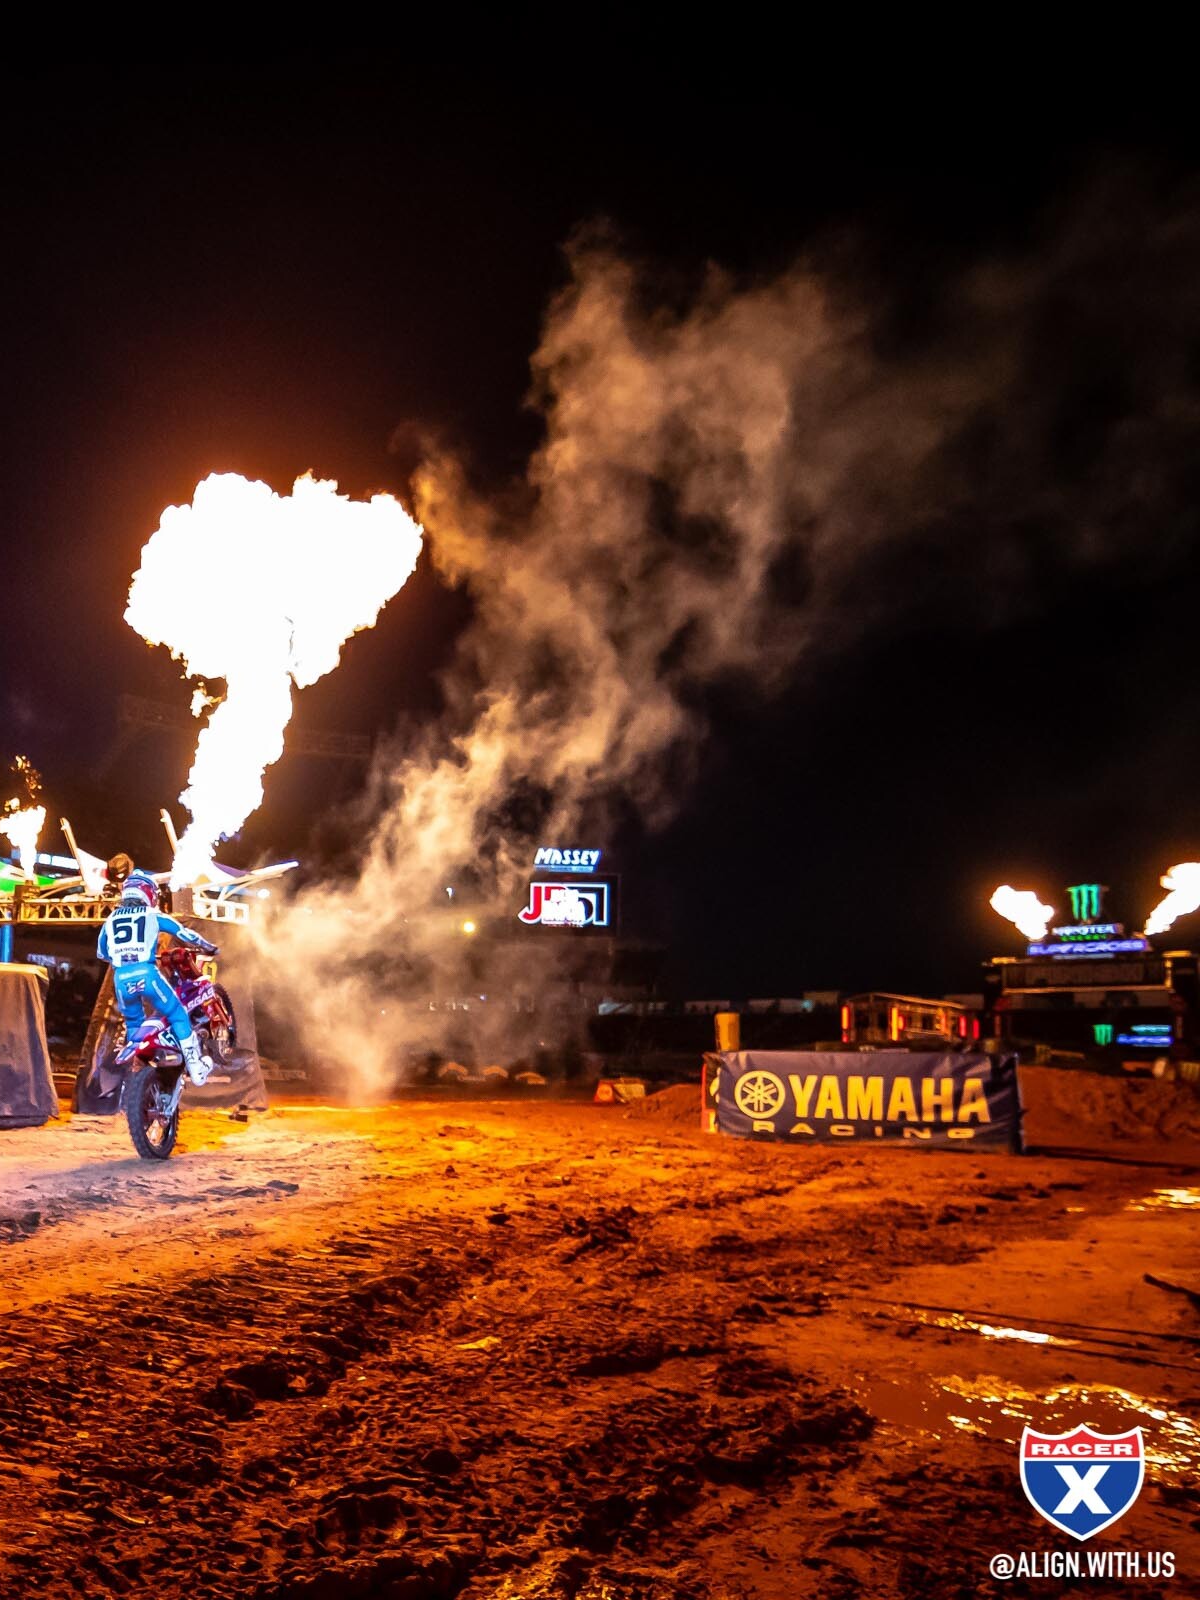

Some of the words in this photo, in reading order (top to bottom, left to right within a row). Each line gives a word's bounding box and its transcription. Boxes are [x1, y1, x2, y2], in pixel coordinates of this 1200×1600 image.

[534, 848, 600, 865] MASSEY
[113, 916, 146, 944] 51
[787, 1074, 992, 1123] YAMAHA
[753, 1121, 976, 1139] RACING
